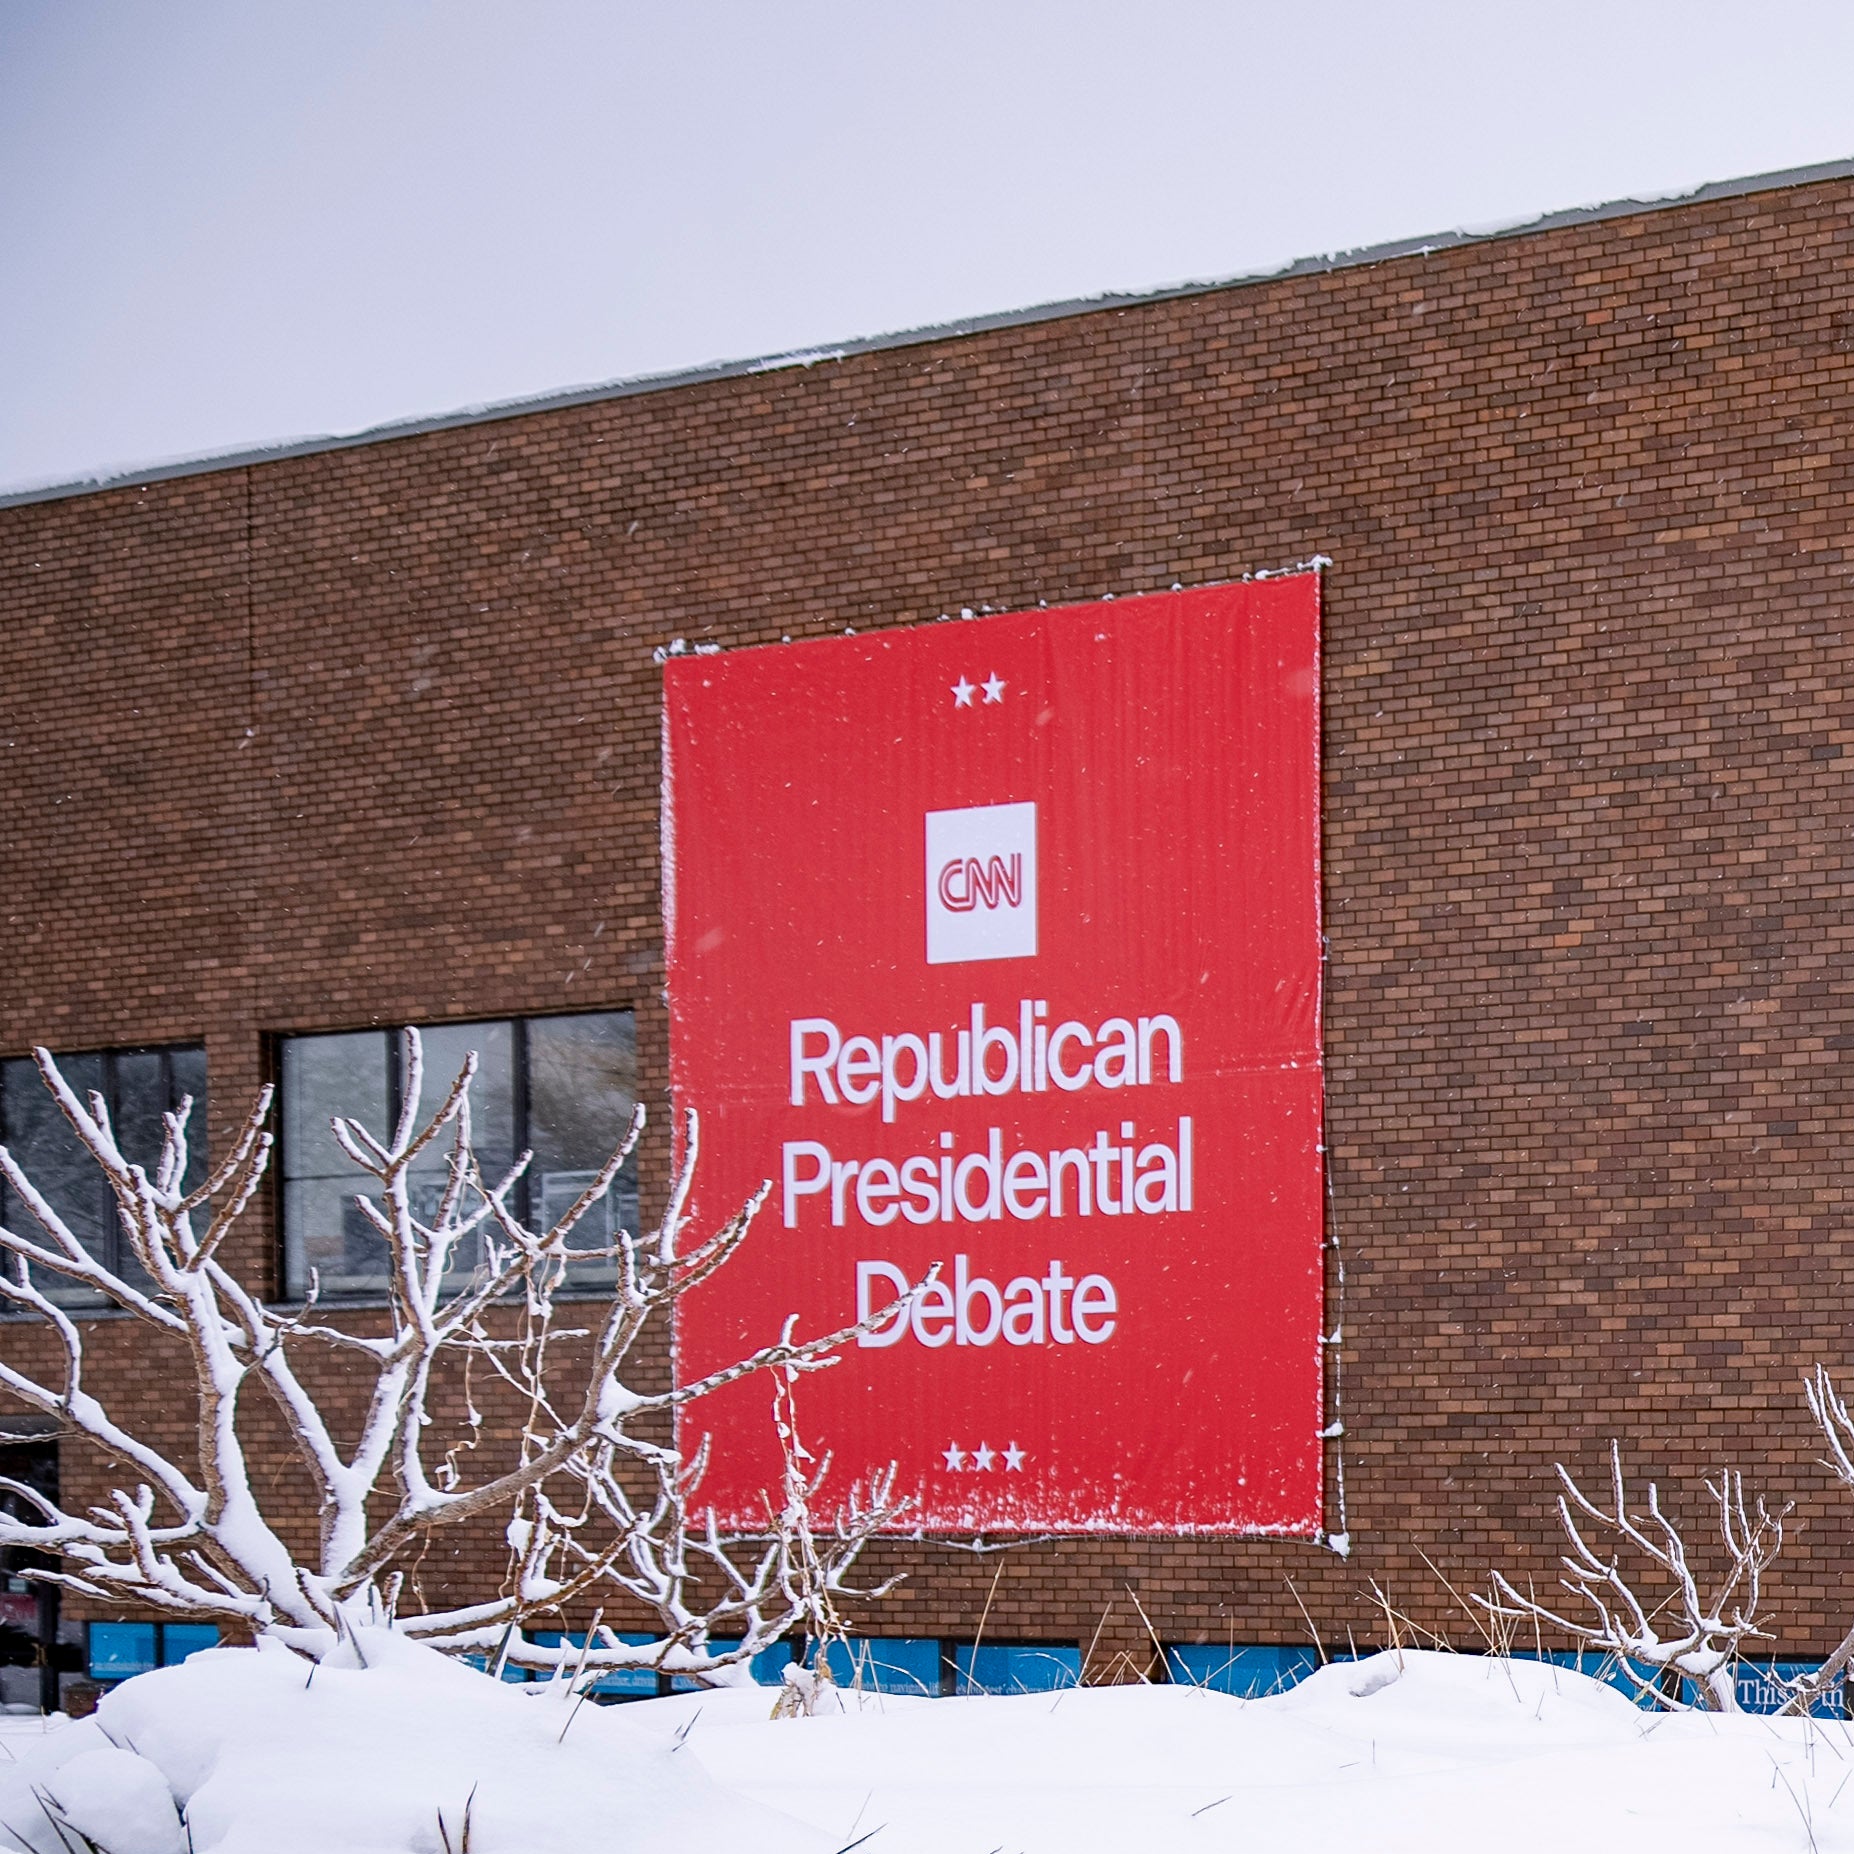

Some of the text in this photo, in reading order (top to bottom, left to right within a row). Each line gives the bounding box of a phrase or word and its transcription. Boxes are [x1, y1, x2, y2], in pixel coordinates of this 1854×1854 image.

[937, 852, 1022, 913] CNN
[789, 999, 1183, 1123] Republican
[783, 1115, 1193, 1229] Presidential
[856, 1253, 1117, 1348] Debate
[1738, 1679, 1788, 1706] This
